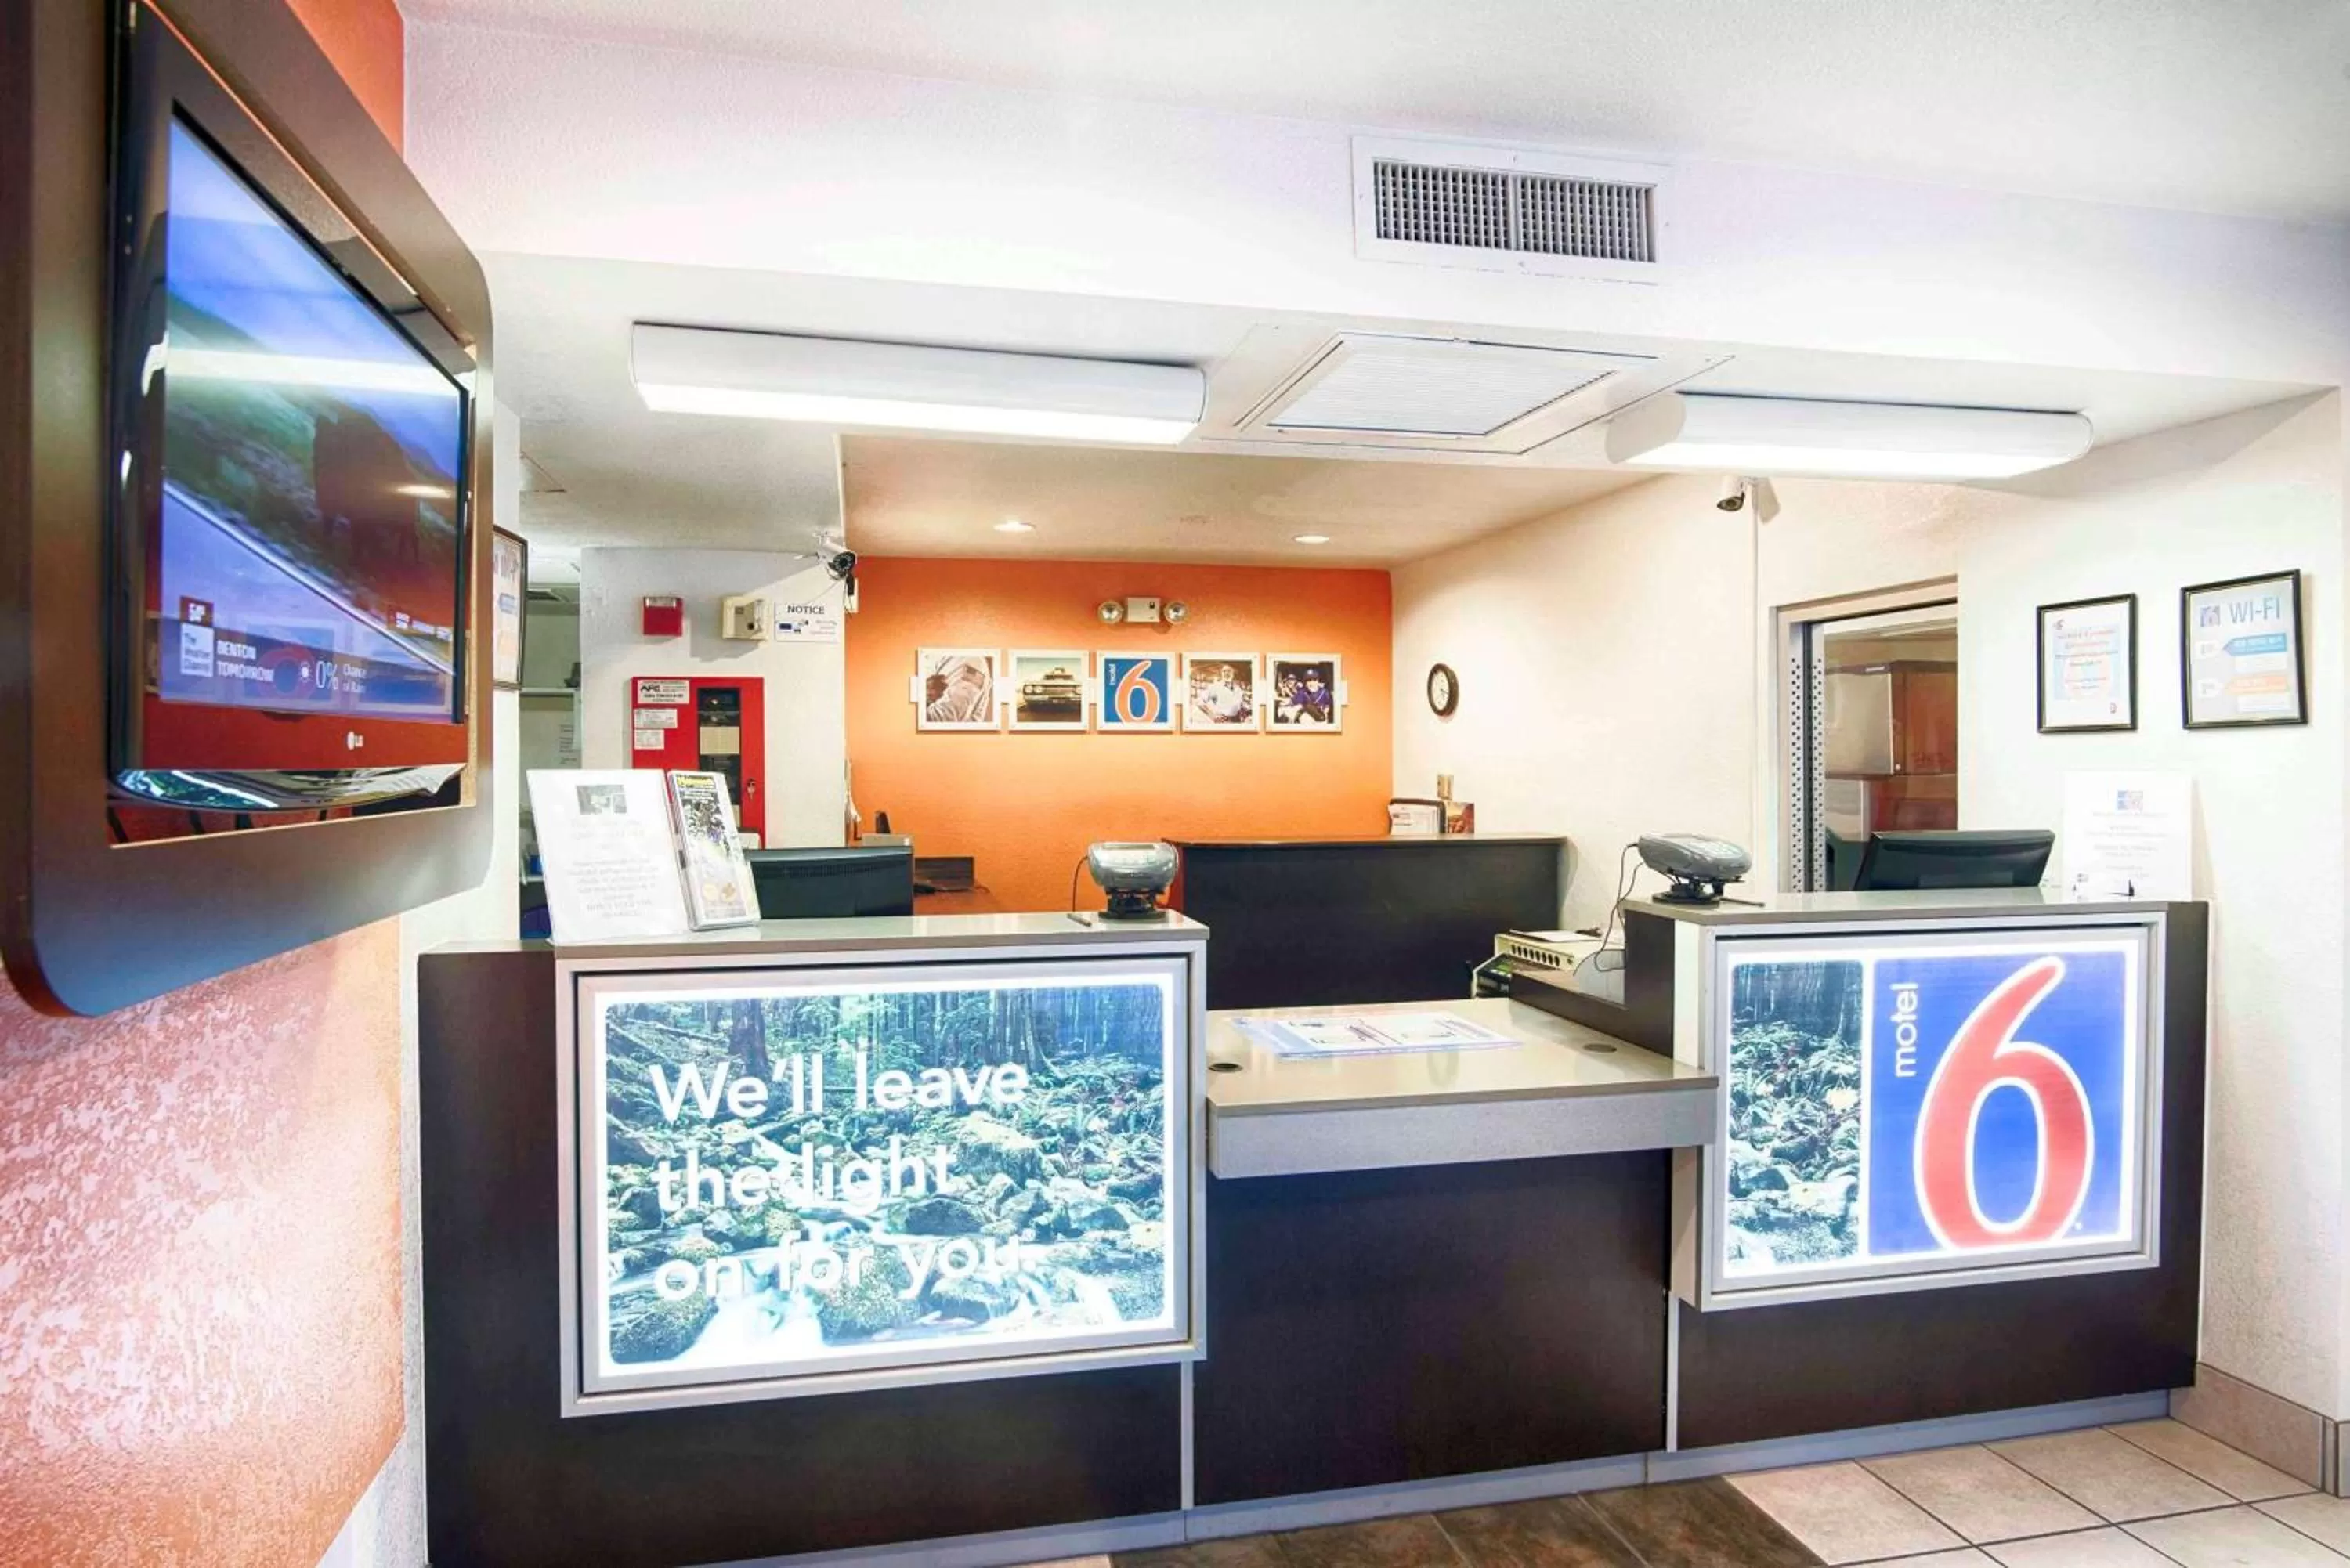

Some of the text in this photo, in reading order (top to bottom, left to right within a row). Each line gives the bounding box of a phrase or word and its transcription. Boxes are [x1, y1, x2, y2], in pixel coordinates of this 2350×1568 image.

[787, 605, 825, 615] NOTICE
[2228, 597, 2280, 623] WI-FI
[1115, 660, 1161, 723] 6
[649, 1050, 1030, 1122] We'll leave
[1889, 955, 2095, 1251] motel 6
[651, 1133, 956, 1218] the light
[654, 1255, 745, 1302] on
[779, 1229, 877, 1292] for
